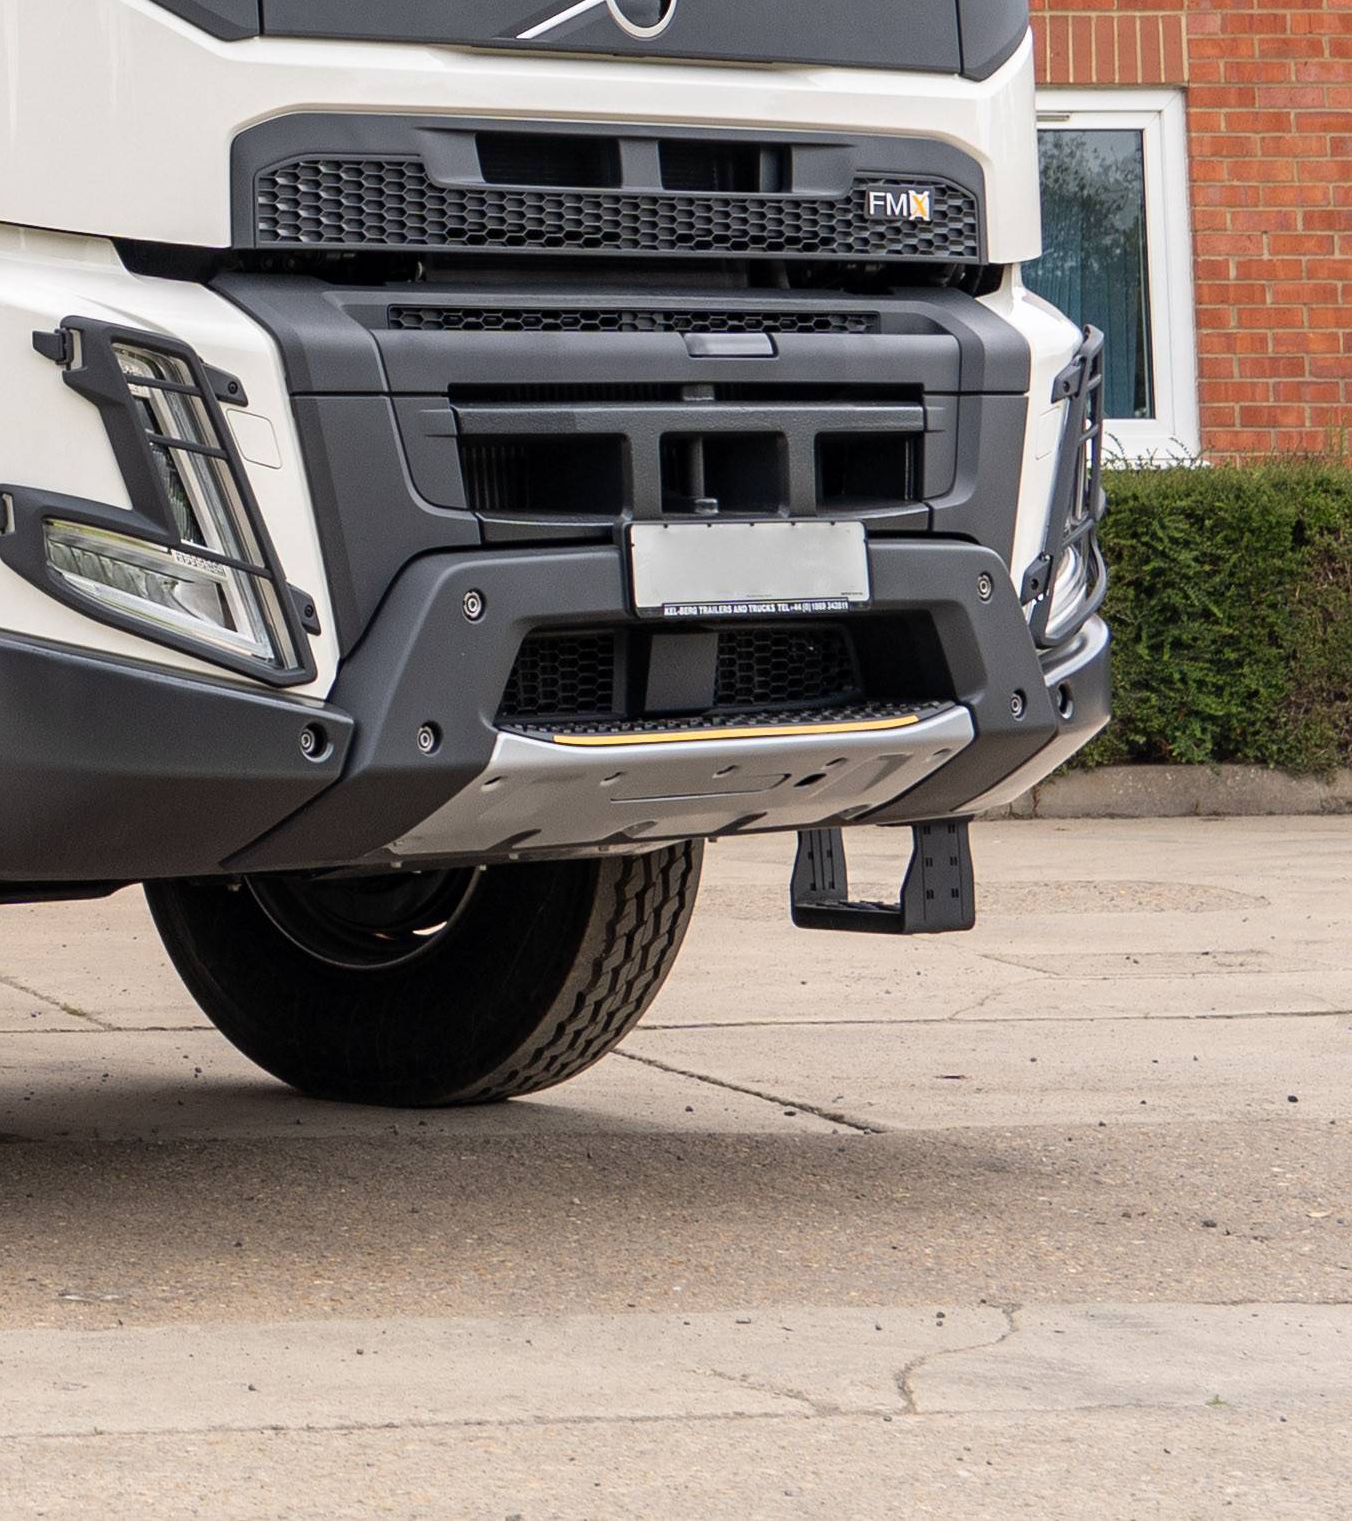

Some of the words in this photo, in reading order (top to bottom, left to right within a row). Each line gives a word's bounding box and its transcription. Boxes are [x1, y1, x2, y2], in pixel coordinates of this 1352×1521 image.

[869, 190, 931, 221] FMX
[664, 606, 698, 616] KEL-BERG
[699, 604, 732, 615] TRAILERS
[733, 604, 747, 614] AND
[748, 603, 775, 613] TRUCKS
